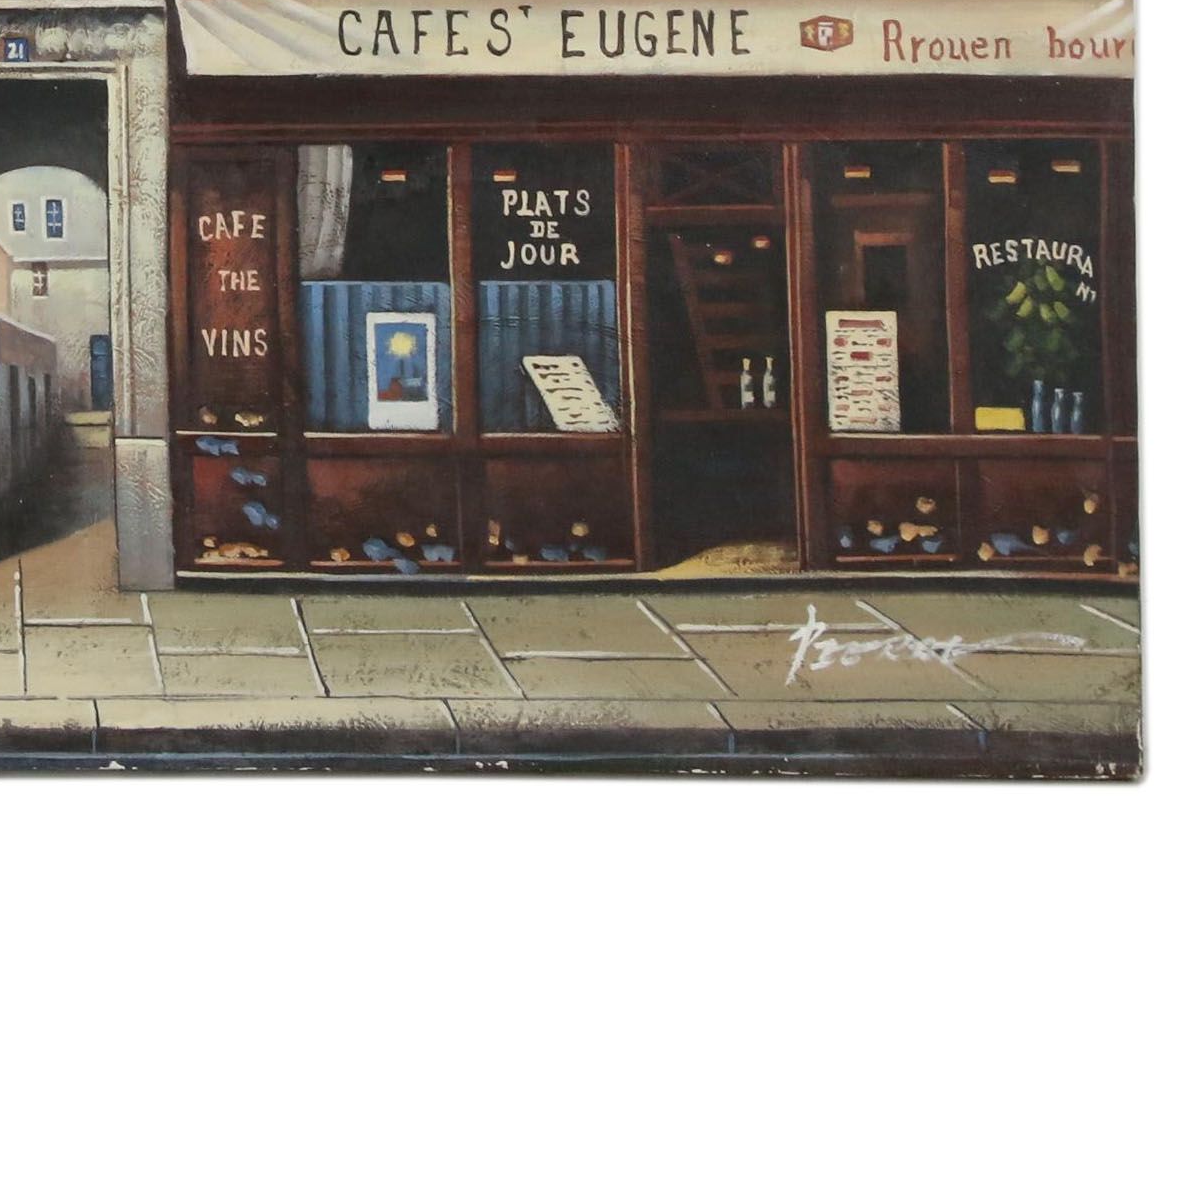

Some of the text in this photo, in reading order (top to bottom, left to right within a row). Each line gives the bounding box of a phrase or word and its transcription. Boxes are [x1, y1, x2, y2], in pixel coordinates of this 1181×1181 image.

[338, 8, 470, 57] CAFE
[561, 8, 751, 59] EUGENE
[882, 18, 1012, 64] Rrouen
[7, 41, 25, 60] 21
[501, 189, 591, 218] PLATS
[198, 210, 267, 242] CAFE
[529, 220, 561, 239] DE
[500, 240, 581, 270] JOUR
[217, 269, 261, 292] THE
[201, 328, 268, 358] VINS
